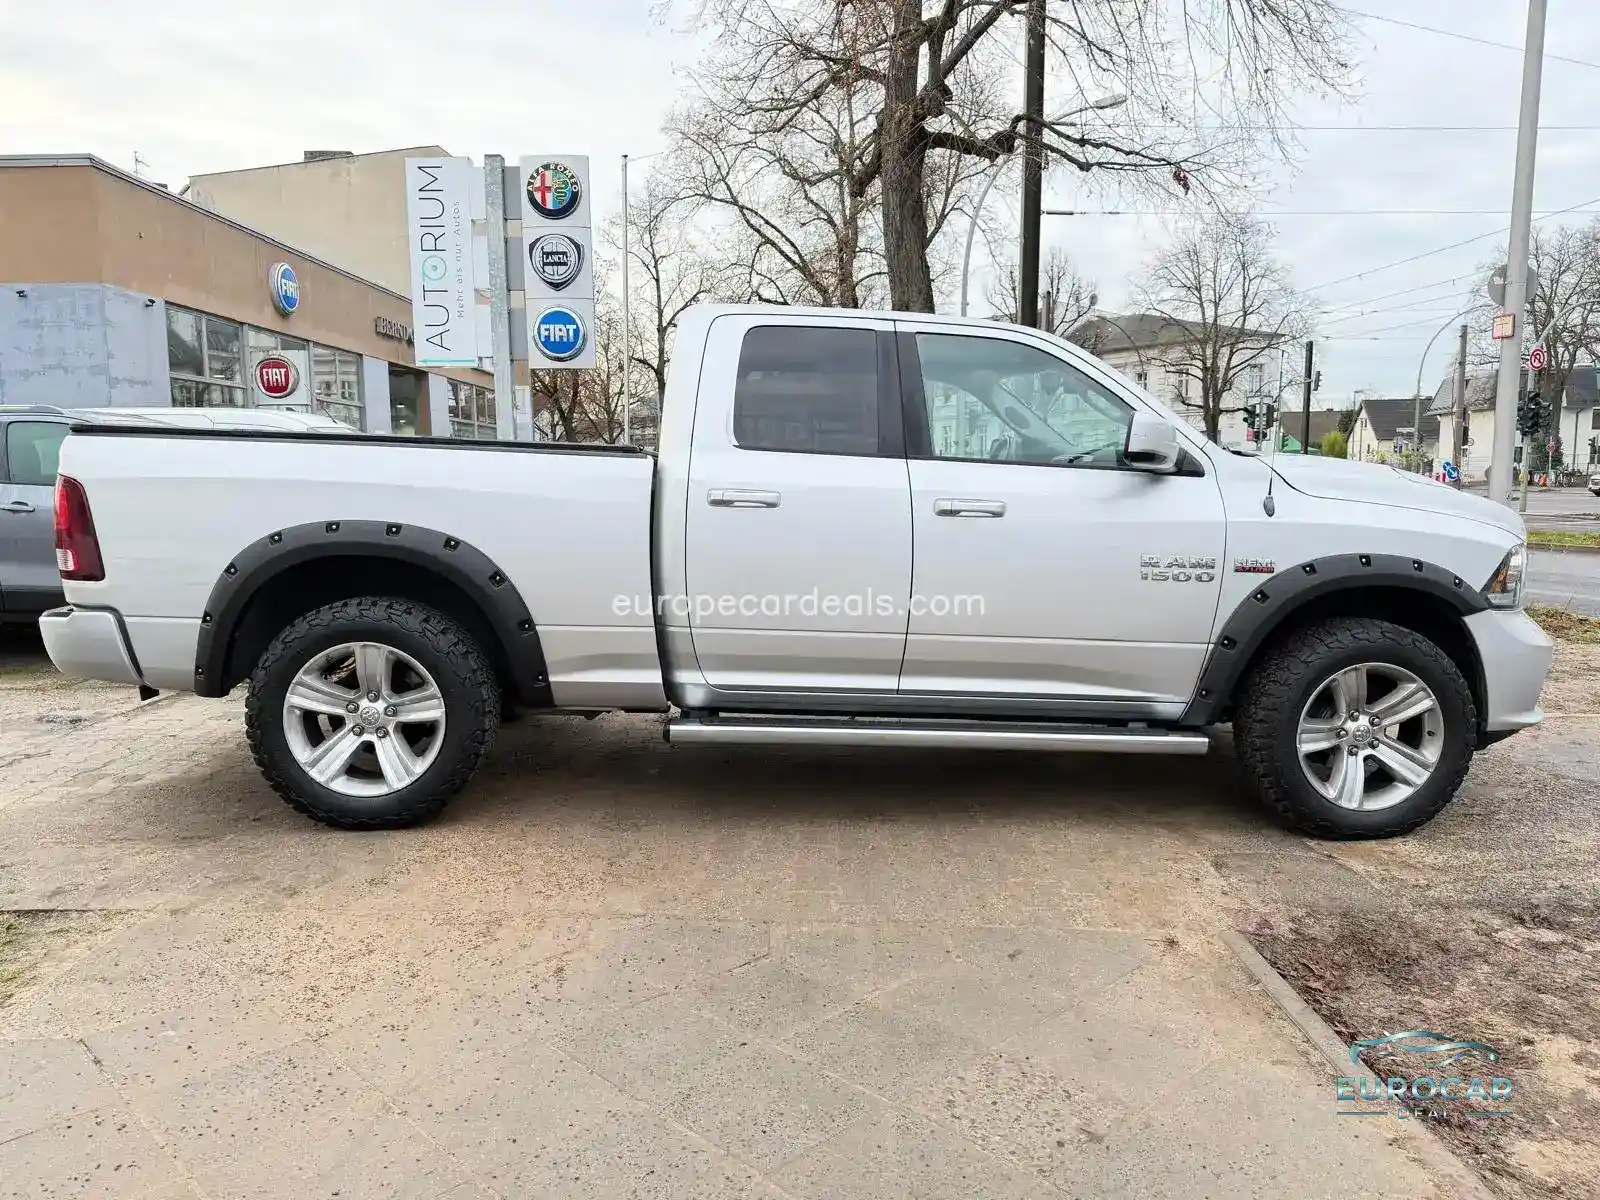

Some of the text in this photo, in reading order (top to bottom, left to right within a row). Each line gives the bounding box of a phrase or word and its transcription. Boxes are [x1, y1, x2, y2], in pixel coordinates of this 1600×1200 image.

[527, 163, 579, 192] ALFA ROMEO
[417, 165, 452, 352] AUTORIUM
[543, 254, 568, 263] LANCIA
[280, 278, 298, 297] FIAT
[539, 323, 577, 343] FIAT
[262, 367, 287, 387] FIAT
[1140, 553, 1216, 570] RAM
[1140, 569, 1215, 583] 1500
